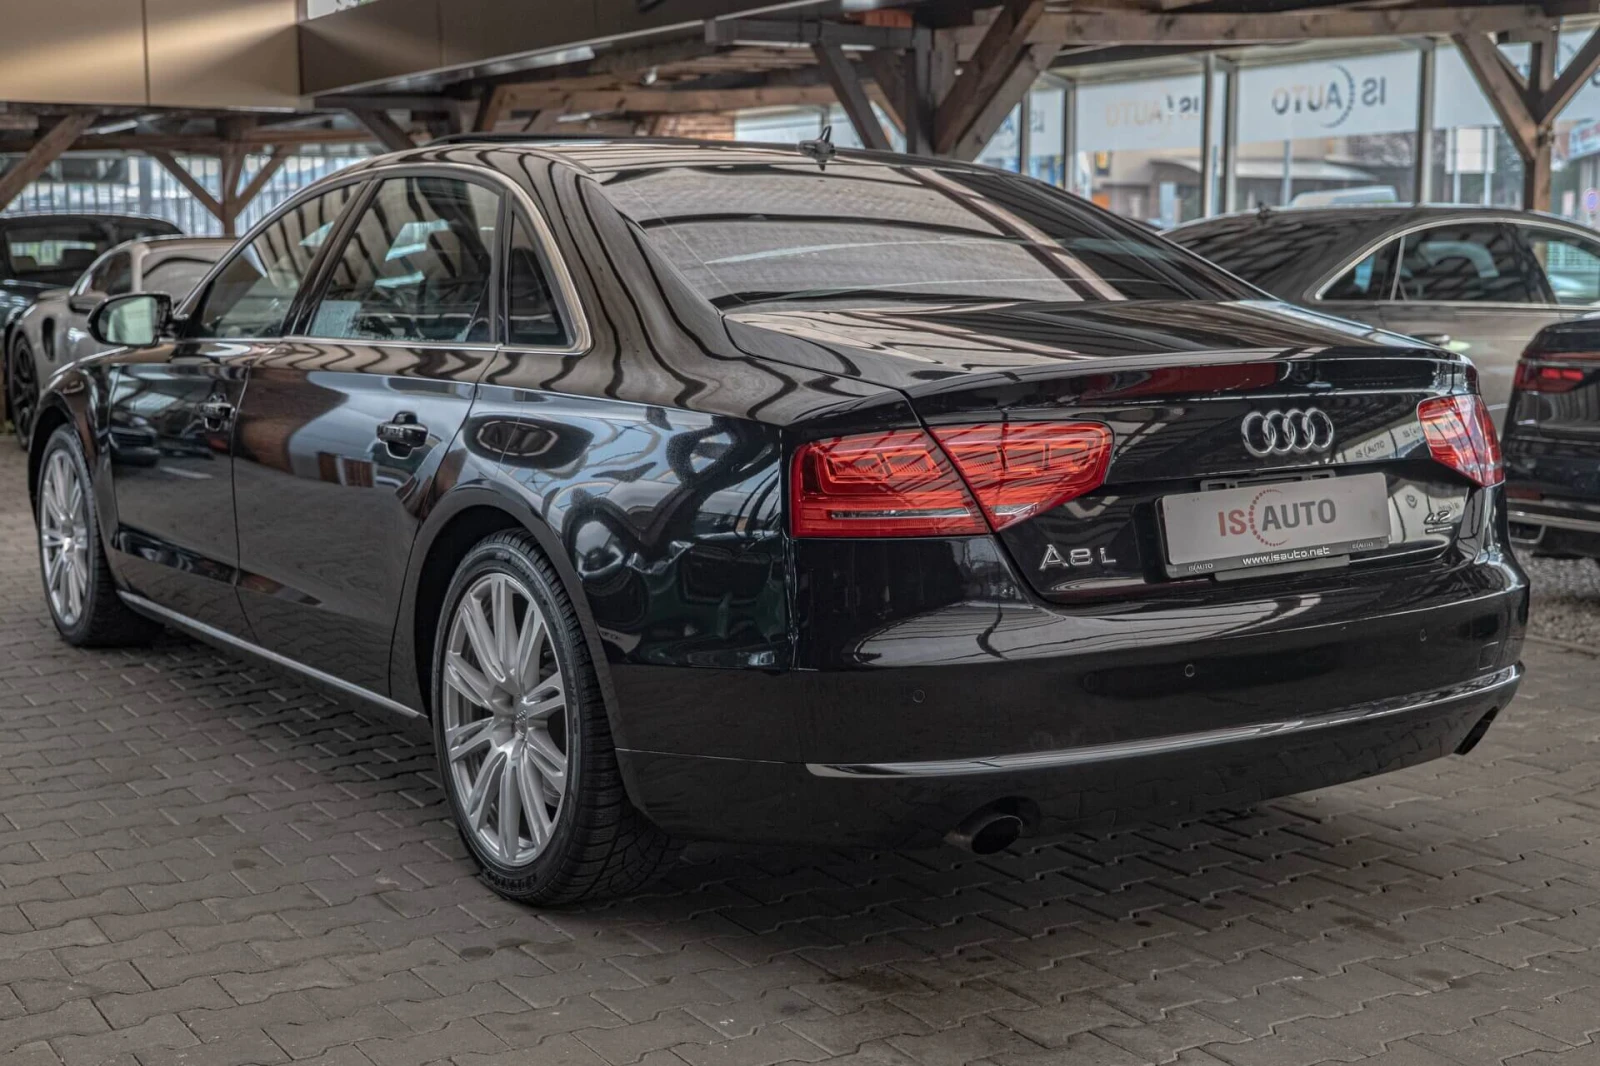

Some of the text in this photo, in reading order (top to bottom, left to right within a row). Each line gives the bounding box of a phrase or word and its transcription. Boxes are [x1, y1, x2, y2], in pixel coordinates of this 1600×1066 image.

[1218, 498, 1336, 537] IS AUTO
[1242, 546, 1330, 566] www.isauto.net
